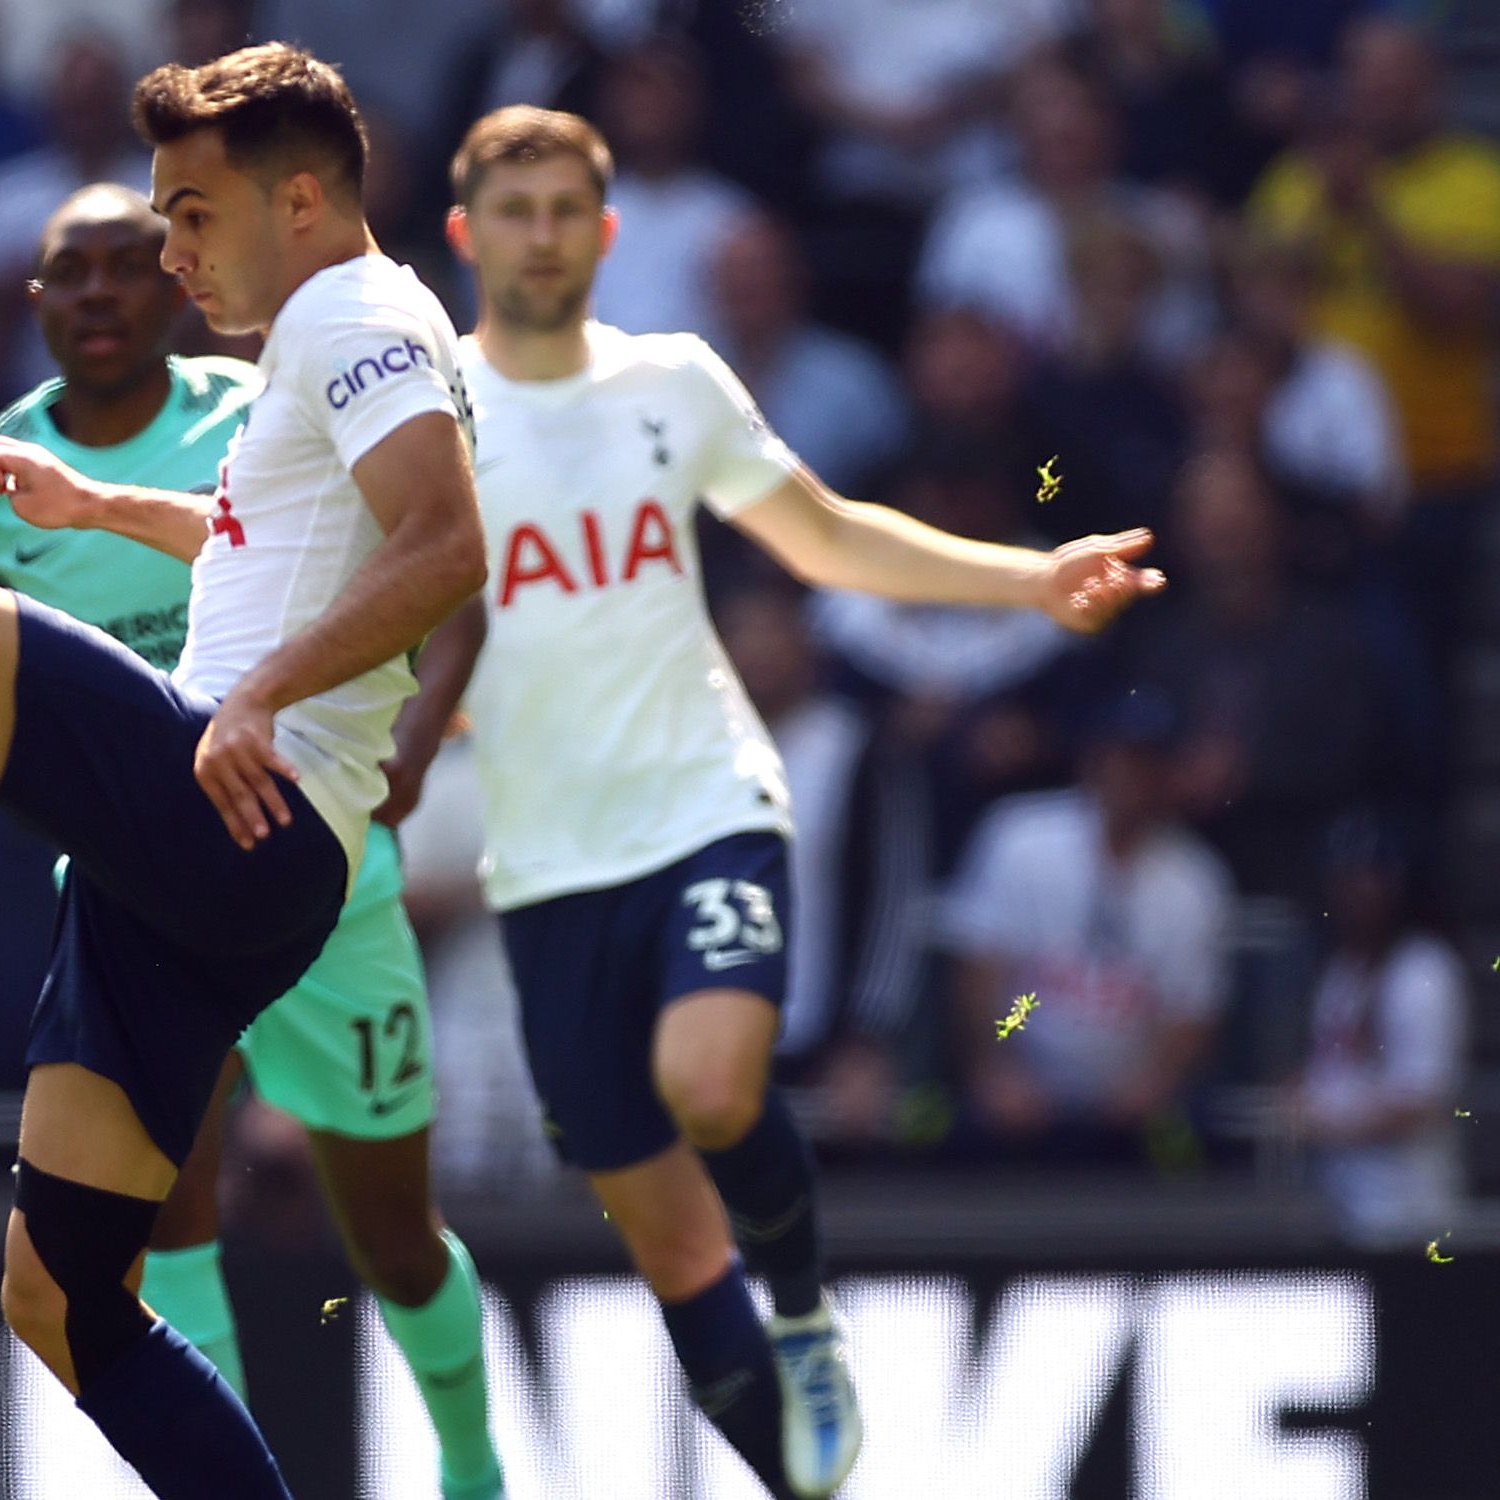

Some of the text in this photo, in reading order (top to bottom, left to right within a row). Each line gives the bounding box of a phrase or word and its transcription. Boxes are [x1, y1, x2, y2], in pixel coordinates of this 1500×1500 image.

[327, 338, 435, 410] cinch
[497, 497, 685, 608] AIA
[681, 877, 784, 954] 33
[349, 1000, 425, 1093] 12
